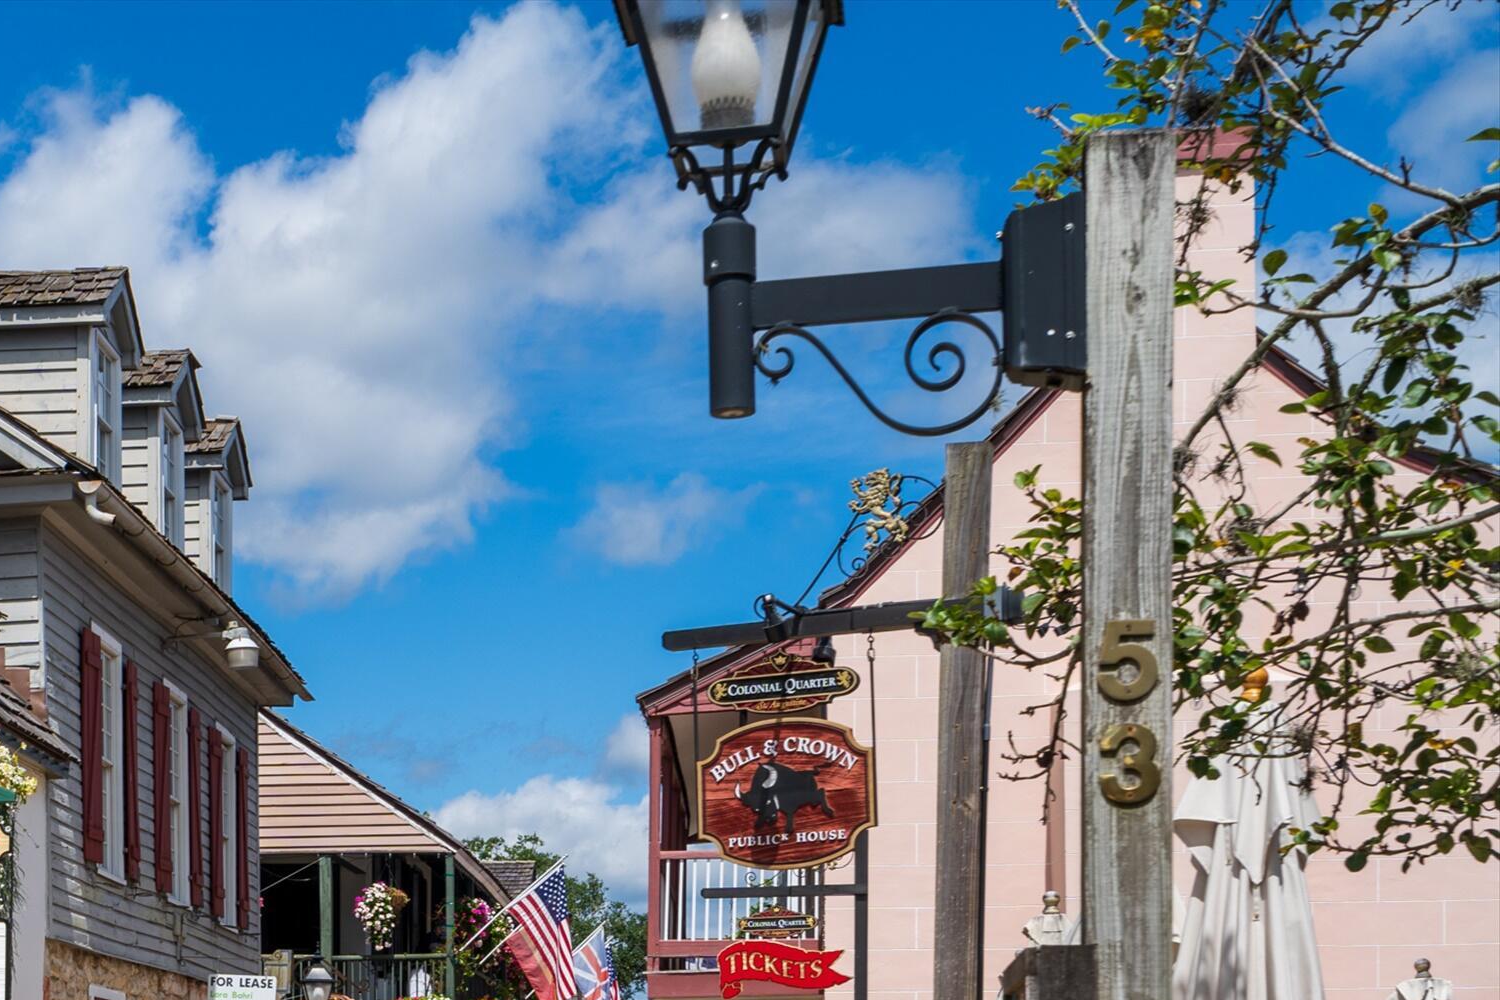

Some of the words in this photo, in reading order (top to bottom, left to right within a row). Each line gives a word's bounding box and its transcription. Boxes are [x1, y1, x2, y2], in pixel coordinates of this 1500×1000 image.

[710, 745, 761, 783] BULL
[763, 739, 779, 757] &
[783, 736, 859, 771] CROWN
[796, 829, 847, 843] HOUSE
[725, 951, 823, 979] TICKETS
[210, 976, 233, 987] FOR
[239, 977, 274, 989] LEASE
